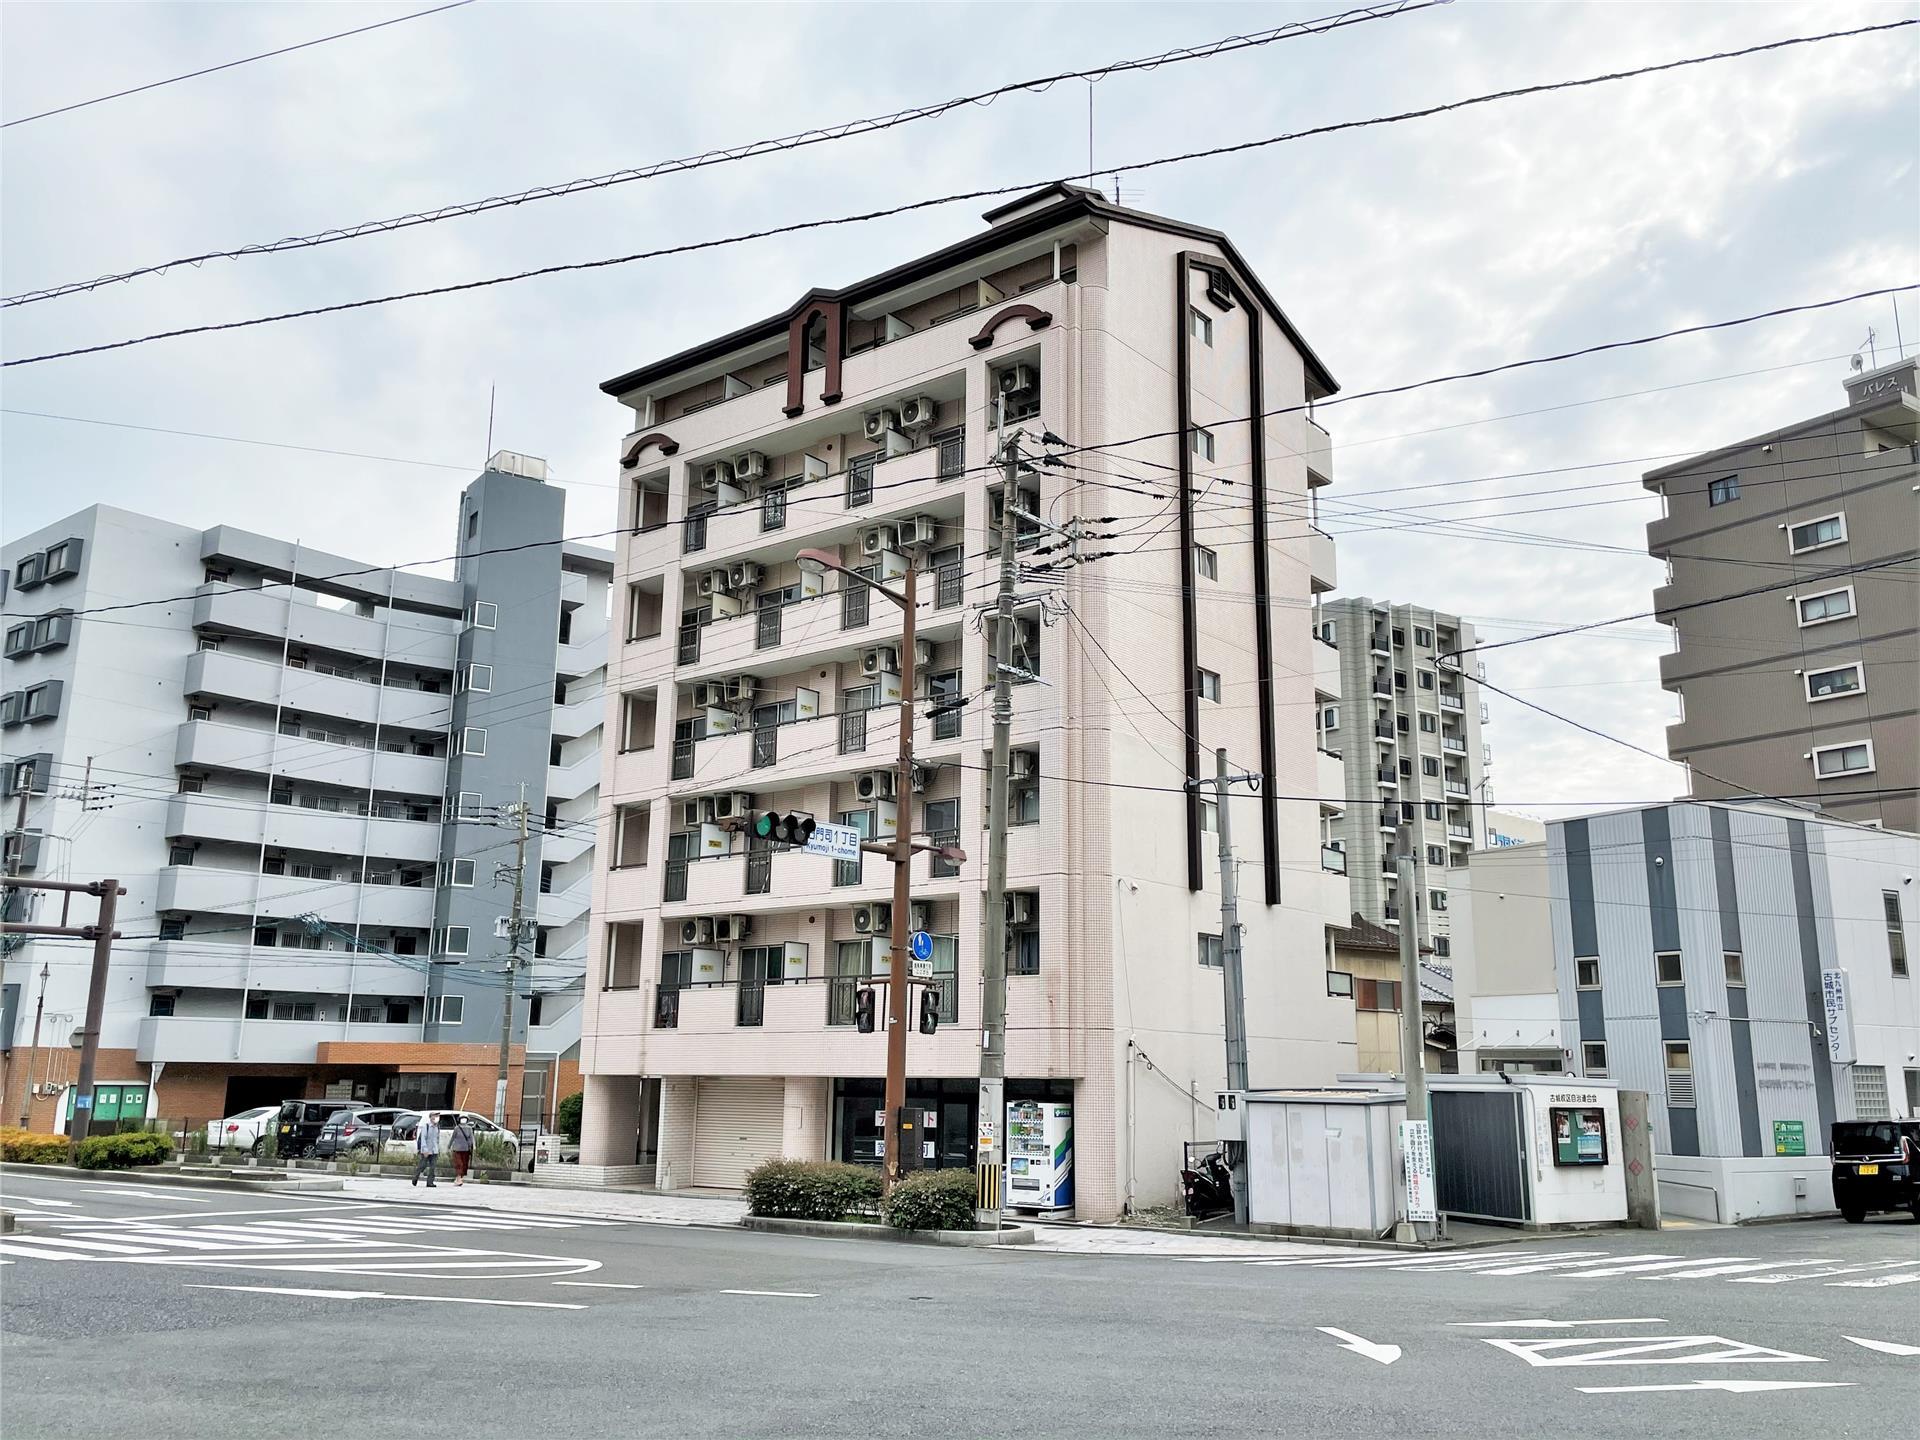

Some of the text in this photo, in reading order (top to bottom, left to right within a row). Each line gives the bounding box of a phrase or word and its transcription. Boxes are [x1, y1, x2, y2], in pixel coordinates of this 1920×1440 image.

[1823, 973, 1840, 1060] 古城市民サブセンター
